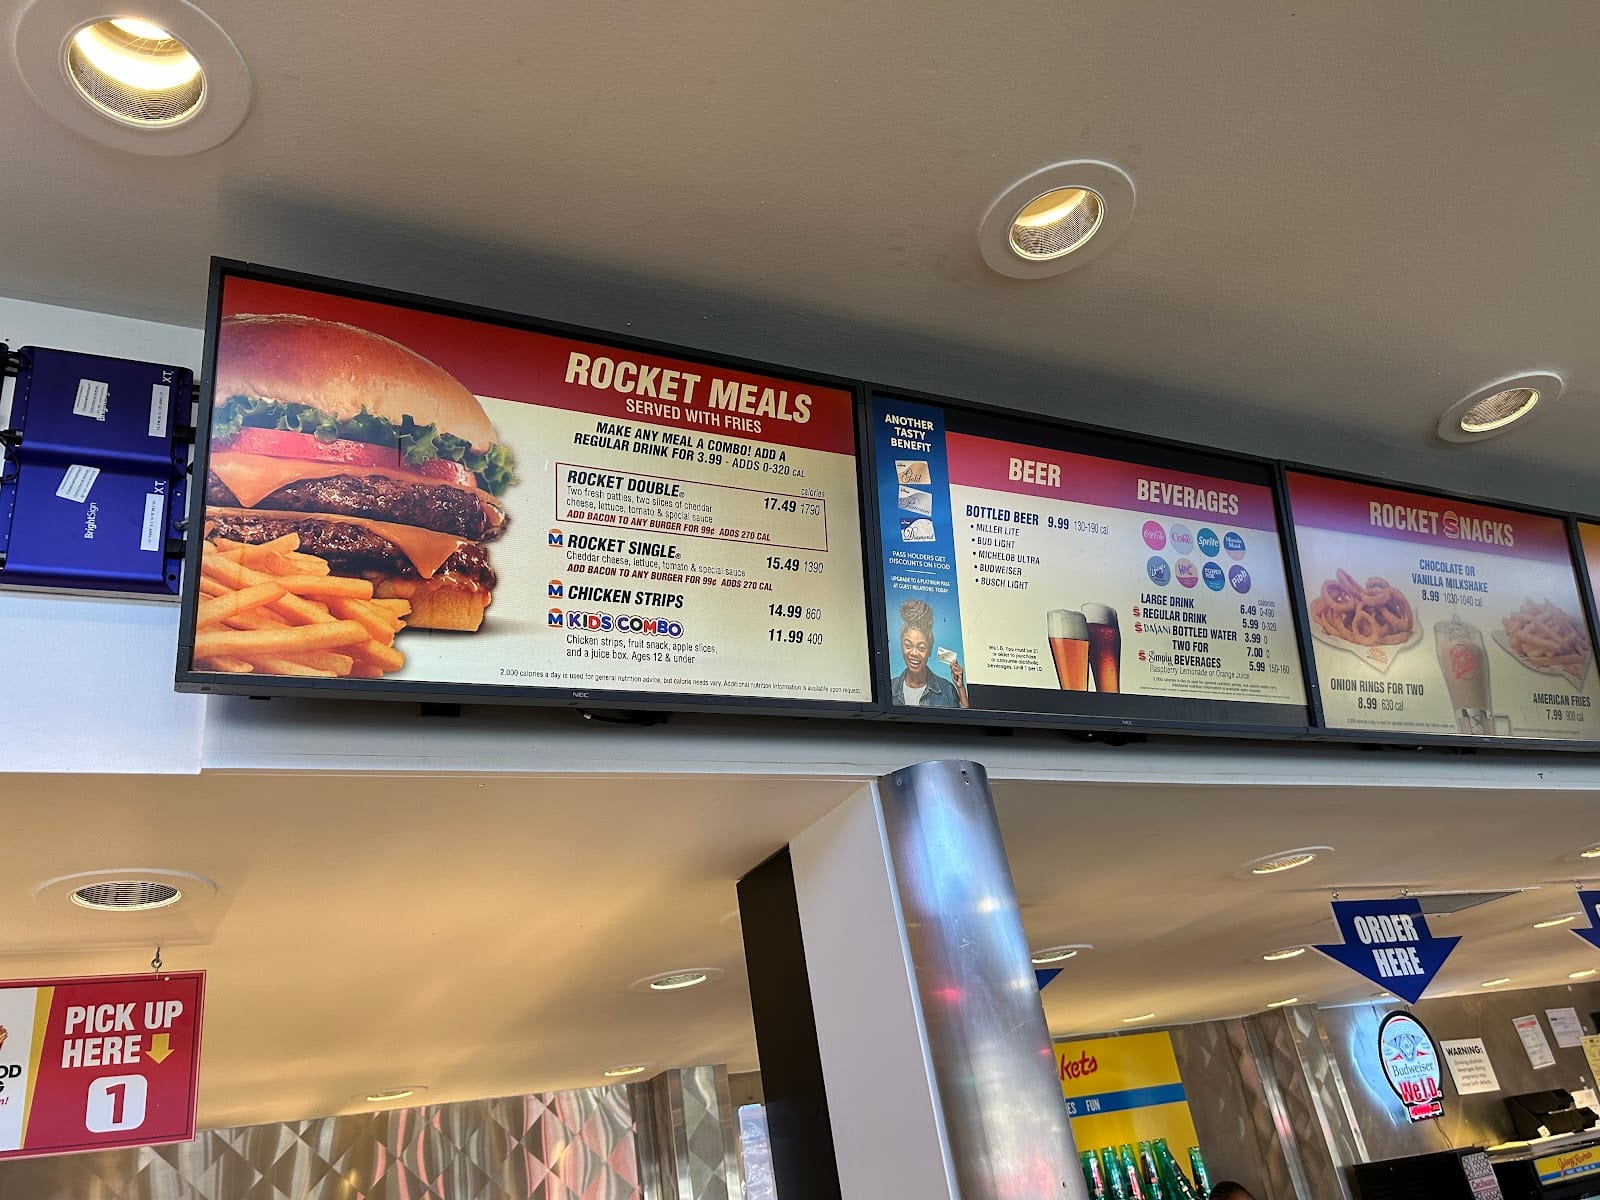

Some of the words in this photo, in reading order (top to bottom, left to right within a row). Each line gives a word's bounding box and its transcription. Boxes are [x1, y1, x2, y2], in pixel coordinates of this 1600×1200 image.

[565, 352, 701, 404] ROCKET
[708, 378, 812, 424] MEALS
[626, 399, 680, 420] SERVED
[685, 408, 720, 427] WITH
[724, 416, 762, 433] FRIES
[885, 413, 934, 431] ANOTHER
[596, 422, 631, 437] MAKE
[634, 428, 659, 441] ANY
[662, 432, 693, 448] MEAL
[696, 438, 704, 449] A
[707, 439, 752, 456] COMBO!
[754, 447, 776, 460] ADD
[779, 451, 786, 461] A
[894, 427, 925, 440] TASTY
[890, 437, 931, 453] BENEFIT
[574, 433, 629, 451] REGULAR
[632, 442, 669, 457] DRINK
[672, 447, 694, 461] FOR
[697, 452, 722, 465] 3.99
[732, 458, 760, 471] ADDS
[763, 463, 790, 475] 0-320
[792, 469, 805, 478] CAL
[567, 470, 624, 489] ROCKET
[1008, 457, 1061, 487] BEER
[800, 488, 825, 498] calories
[1137, 478, 1239, 515] BEVERAGES
[566, 498, 596, 510] cheese,
[684, 501, 712, 513] cheddar
[764, 497, 796, 512] 17.49
[800, 503, 820, 515] 1790
[84, 502, 98, 539] BrightSign
[567, 510, 585, 519] ADD
[587, 512, 616, 523] BACON
[618, 515, 628, 525] TO
[630, 517, 648, 527] ANY
[649, 520, 681, 531] BURGER
[683, 523, 699, 533] FOR
[719, 528, 739, 538] ADDS
[741, 530, 755, 540] 270
[756, 533, 770, 541] CAL
[966, 505, 1010, 521] BOTTLED
[1013, 512, 1039, 526] BEER
[1048, 516, 1069, 530] 9.99
[1073, 521, 1099, 534] 130-190
[1369, 501, 1438, 535] ROCKET
[976, 523, 1003, 534] MILLER
[1004, 527, 1020, 536] LITE
[567, 534, 625, 552] ROCKET
[977, 537, 992, 546] BUD
[994, 539, 1015, 549] LIGHT
[1198, 536, 1219, 547] Sprite
[566, 550, 599, 562] Cheddar
[889, 558, 923, 567] DISCOUNTS
[907, 552, 934, 560] HOLDERS
[978, 550, 1015, 561] MICHELOB
[1017, 554, 1040, 564] ULTRA
[766, 557, 800, 571] 15.49
[803, 560, 824, 574] 1390
[979, 563, 1022, 576] BUDWEISER
[1419, 558, 1463, 575] CHOCOLATE
[1465, 566, 1476, 577] OR
[567, 563, 585, 572] ADD
[587, 566, 616, 576] BACON
[619, 568, 629, 578] TO
[631, 570, 649, 579] ANY
[651, 573, 683, 583] BURGER
[685, 575, 700, 584] FOR
[721, 578, 741, 588] ADDS
[743, 581, 757, 590] 270
[759, 582, 773, 591] CAL
[981, 577, 1006, 588] BUSCH
[1007, 580, 1029, 590] LIGHT
[1411, 573, 1444, 588] VANILLA
[1445, 577, 1488, 593] MILKSHAKE
[568, 585, 631, 605] CHICKEN
[634, 591, 684, 609] STRIPS
[1141, 593, 1167, 606] LARGE
[1169, 596, 1194, 609] DRINK
[1240, 604, 1257, 616] 6.49
[1421, 589, 1439, 602] 8.99
[768, 604, 802, 619] 14.99
[805, 608, 821, 620] 860
[1143, 607, 1180, 621] REGULAR
[1183, 611, 1207, 624] DRINK
[1242, 618, 1259, 630] 5.99
[567, 611, 613, 631] KID'S
[616, 615, 683, 638] COMBO
[1143, 623, 1171, 635] DASANI
[1172, 625, 1208, 639] BOTTLED
[1210, 629, 1237, 642] WATER
[1244, 632, 1261, 644] 3.99
[566, 634, 599, 646] Chicken
[601, 637, 626, 648] strips,
[628, 639, 644, 648] fruit
[646, 641, 671, 652] snack,
[672, 643, 693, 654] apple
[768, 629, 803, 644] 11.99
[807, 633, 823, 645] 400
[566, 648, 582, 658] and
[591, 649, 610, 659] juice
[612, 651, 629, 660] box.
[631, 652, 651, 663] Ages
[653, 652, 663, 662] 12
[673, 655, 695, 664] under
[1172, 639, 1191, 651] TWO
[1193, 642, 1209, 653] FOR
[1246, 647, 1263, 658] 7.00
[1148, 650, 1173, 666] Simply
[1174, 655, 1221, 668] BEVERAGES
[1249, 661, 1266, 672] 5.99
[1330, 678, 1357, 692] ONION
[1359, 679, 1385, 694] RINGS
[1387, 682, 1404, 695] FOR
[1405, 683, 1424, 696] TWO
[1357, 697, 1377, 710] 8.99
[1381, 699, 1394, 710] 630
[1533, 692, 1570, 707] AMERICAN
[1571, 695, 1591, 708] FRIES
[1546, 709, 1562, 721] 7.99
[1565, 710, 1576, 721] 900
[1354, 914, 1419, 945] ORDER
[1372, 946, 1425, 978] HERE
[64, 1002, 136, 1035] PICK
[144, 1000, 184, 1030] UP
[61, 1034, 142, 1069] HERE
[1445, 1045, 1484, 1056] WARNING:
[1059, 1050, 1098, 1082] kets
[1391, 1062, 1434, 1077] Budweiser
[1399, 1081, 1422, 1103] We
[105, 1083, 126, 1124] 1
[1085, 1098, 1101, 1112] FUN
